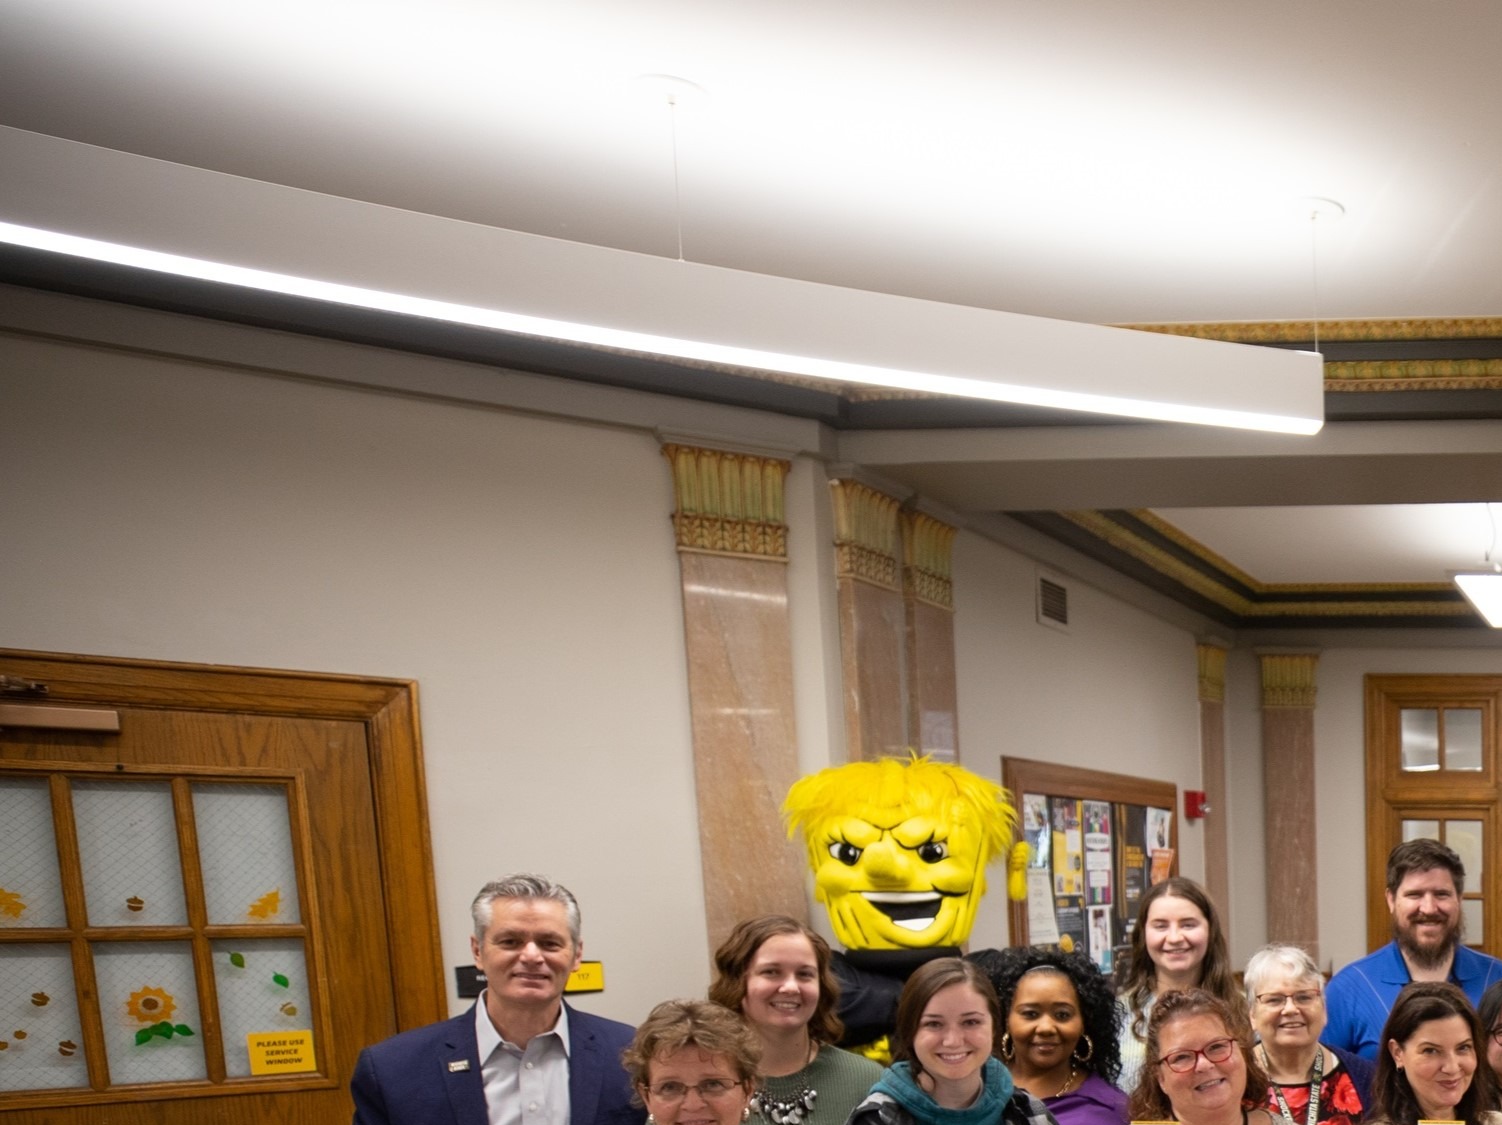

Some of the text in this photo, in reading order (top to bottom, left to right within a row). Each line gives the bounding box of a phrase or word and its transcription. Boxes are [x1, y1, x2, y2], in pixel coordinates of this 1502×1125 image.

[256, 1038, 305, 1048] PLEASE USE
[265, 1048, 299, 1056] SERVICE
[265, 1057, 303, 1065] WINDOW
[1310, 1084, 1321, 1104] STATE
